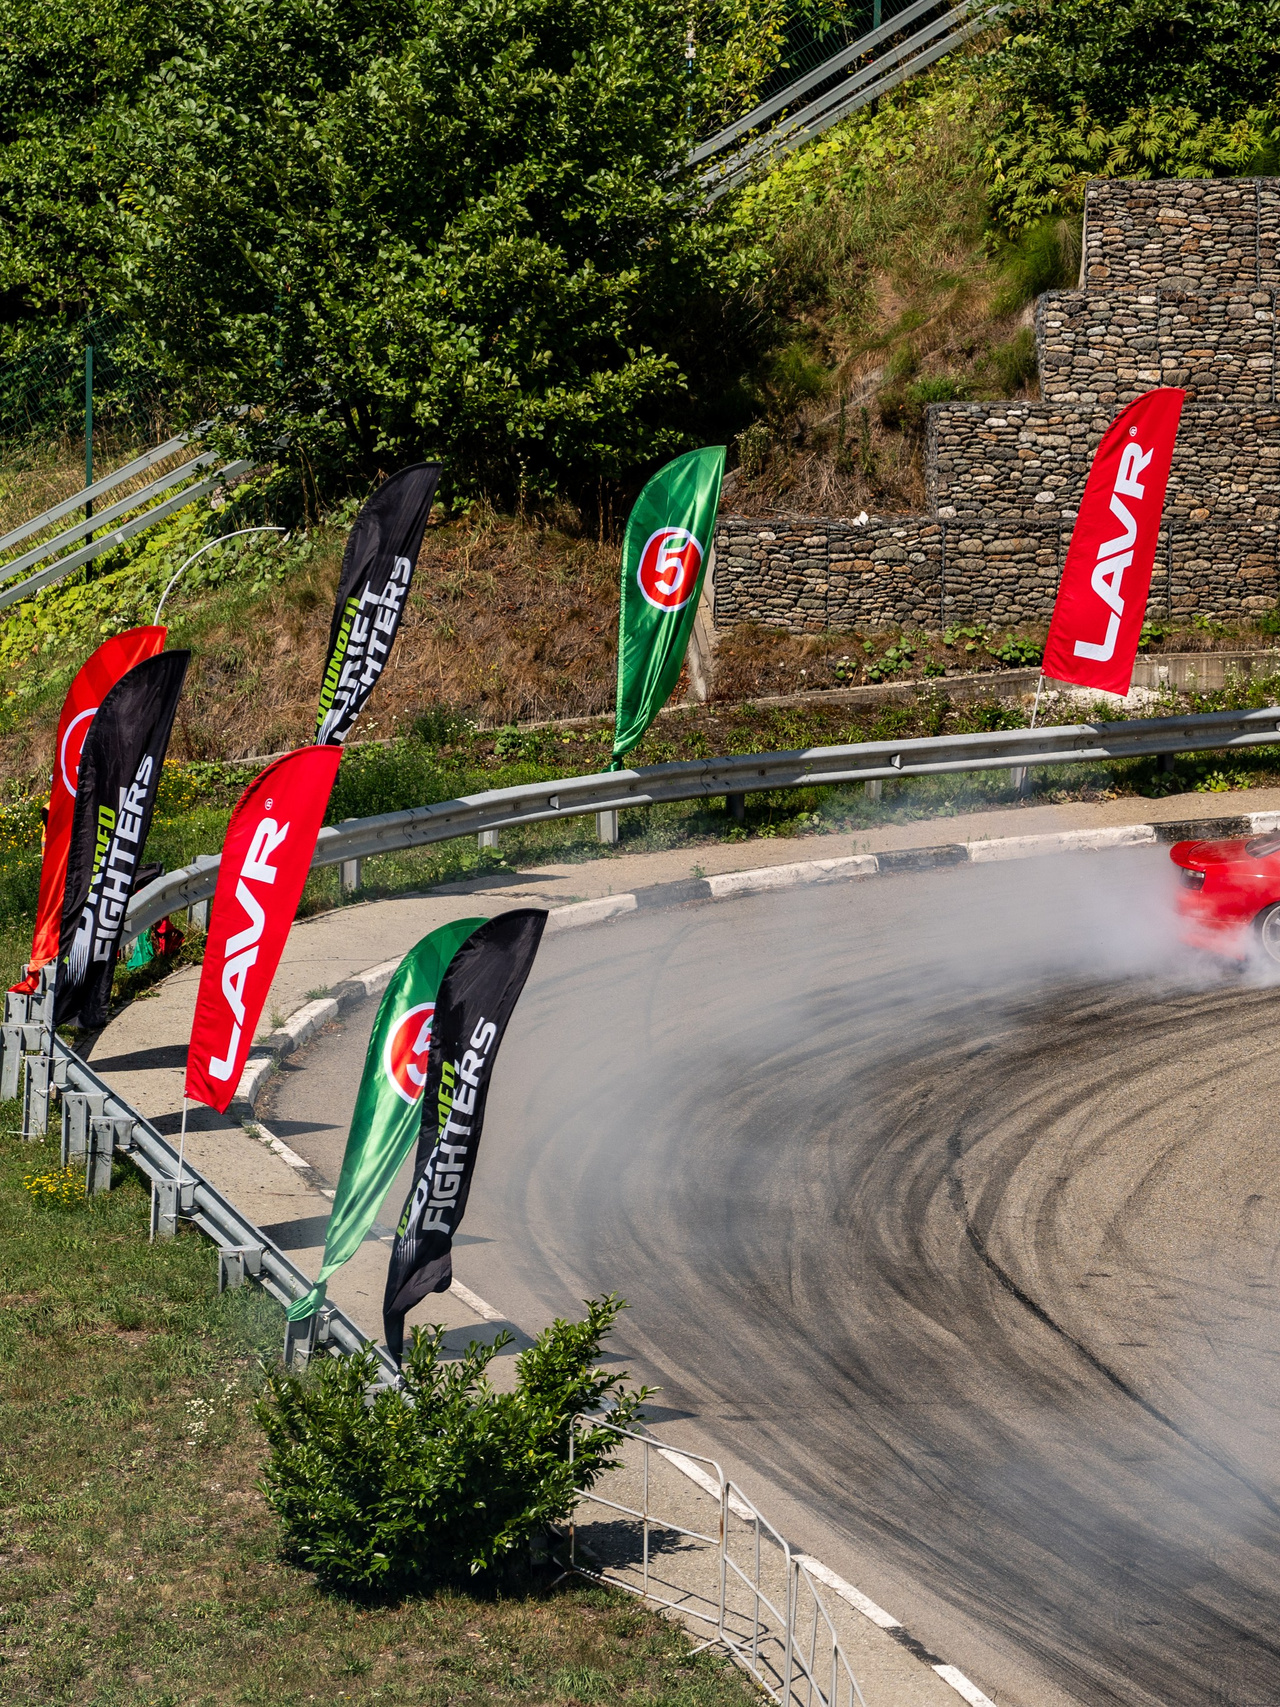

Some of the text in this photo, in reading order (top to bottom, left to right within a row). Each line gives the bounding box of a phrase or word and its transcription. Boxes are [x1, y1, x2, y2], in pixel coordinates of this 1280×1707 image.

[314, 597, 360, 740] ROUNDED
[93, 753, 153, 961] FIGHTERS
[422, 1017, 497, 1234] FIGHTERS
